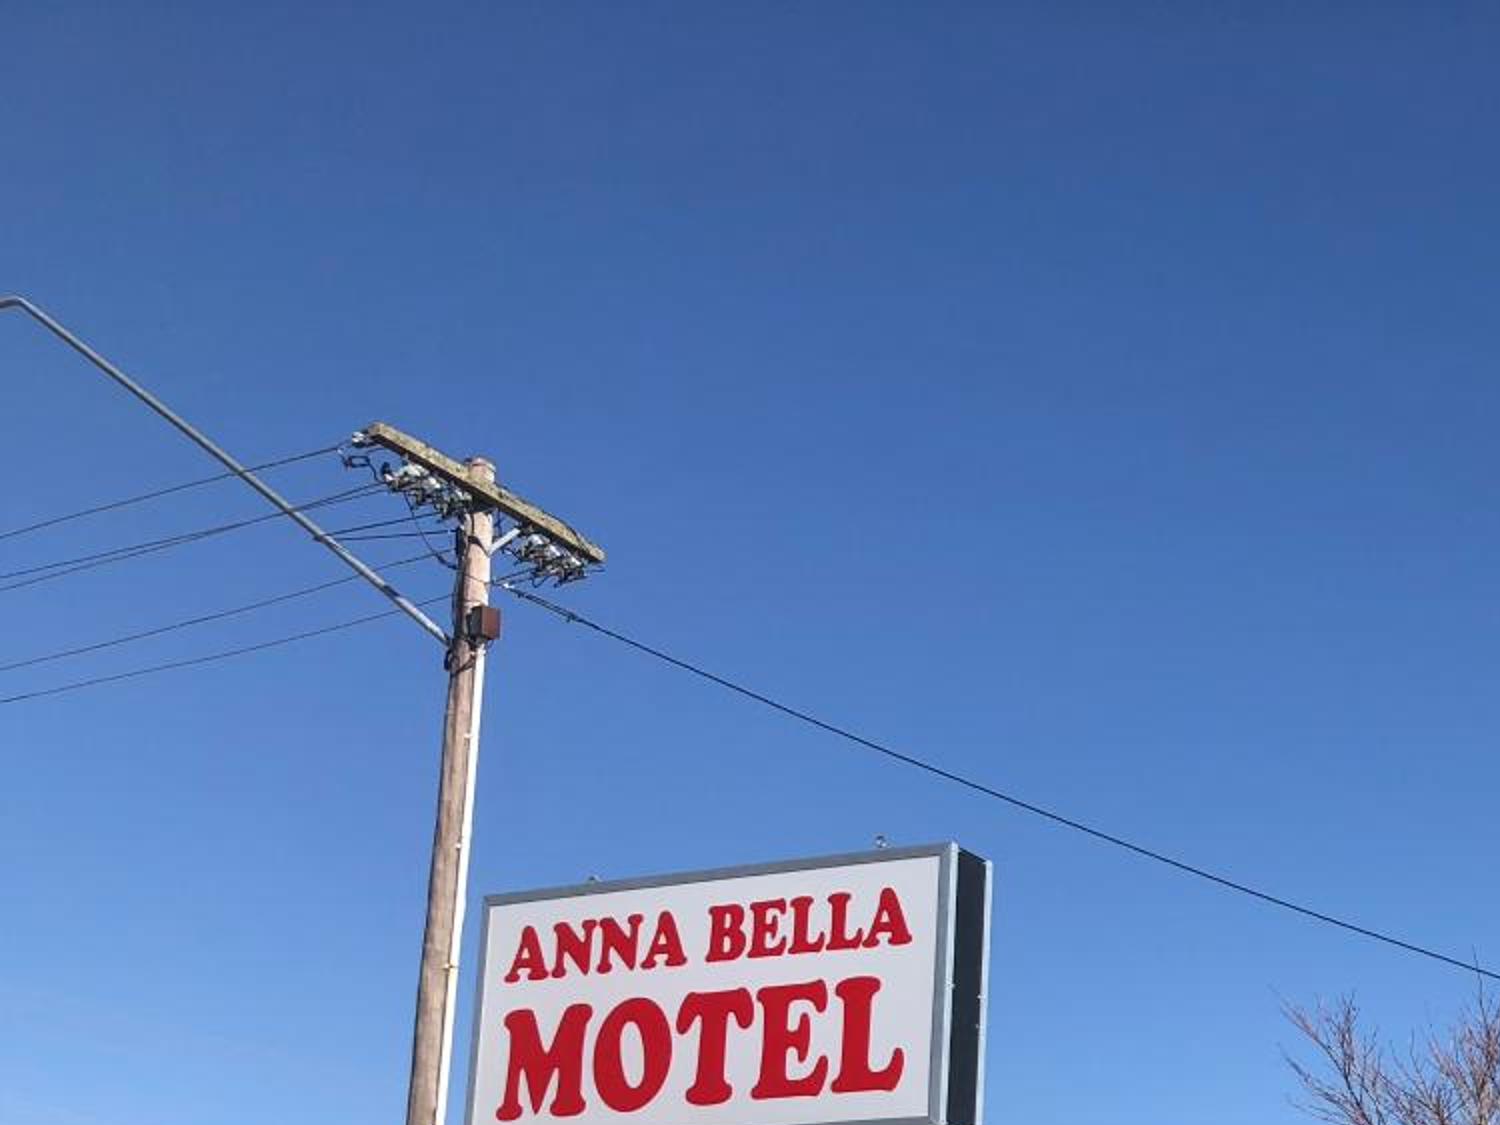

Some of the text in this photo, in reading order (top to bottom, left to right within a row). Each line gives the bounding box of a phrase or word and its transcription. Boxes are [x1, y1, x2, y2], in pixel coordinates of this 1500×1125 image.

[504, 887, 912, 984] ANNA BELLA
[495, 976, 905, 1122] MOTEL
